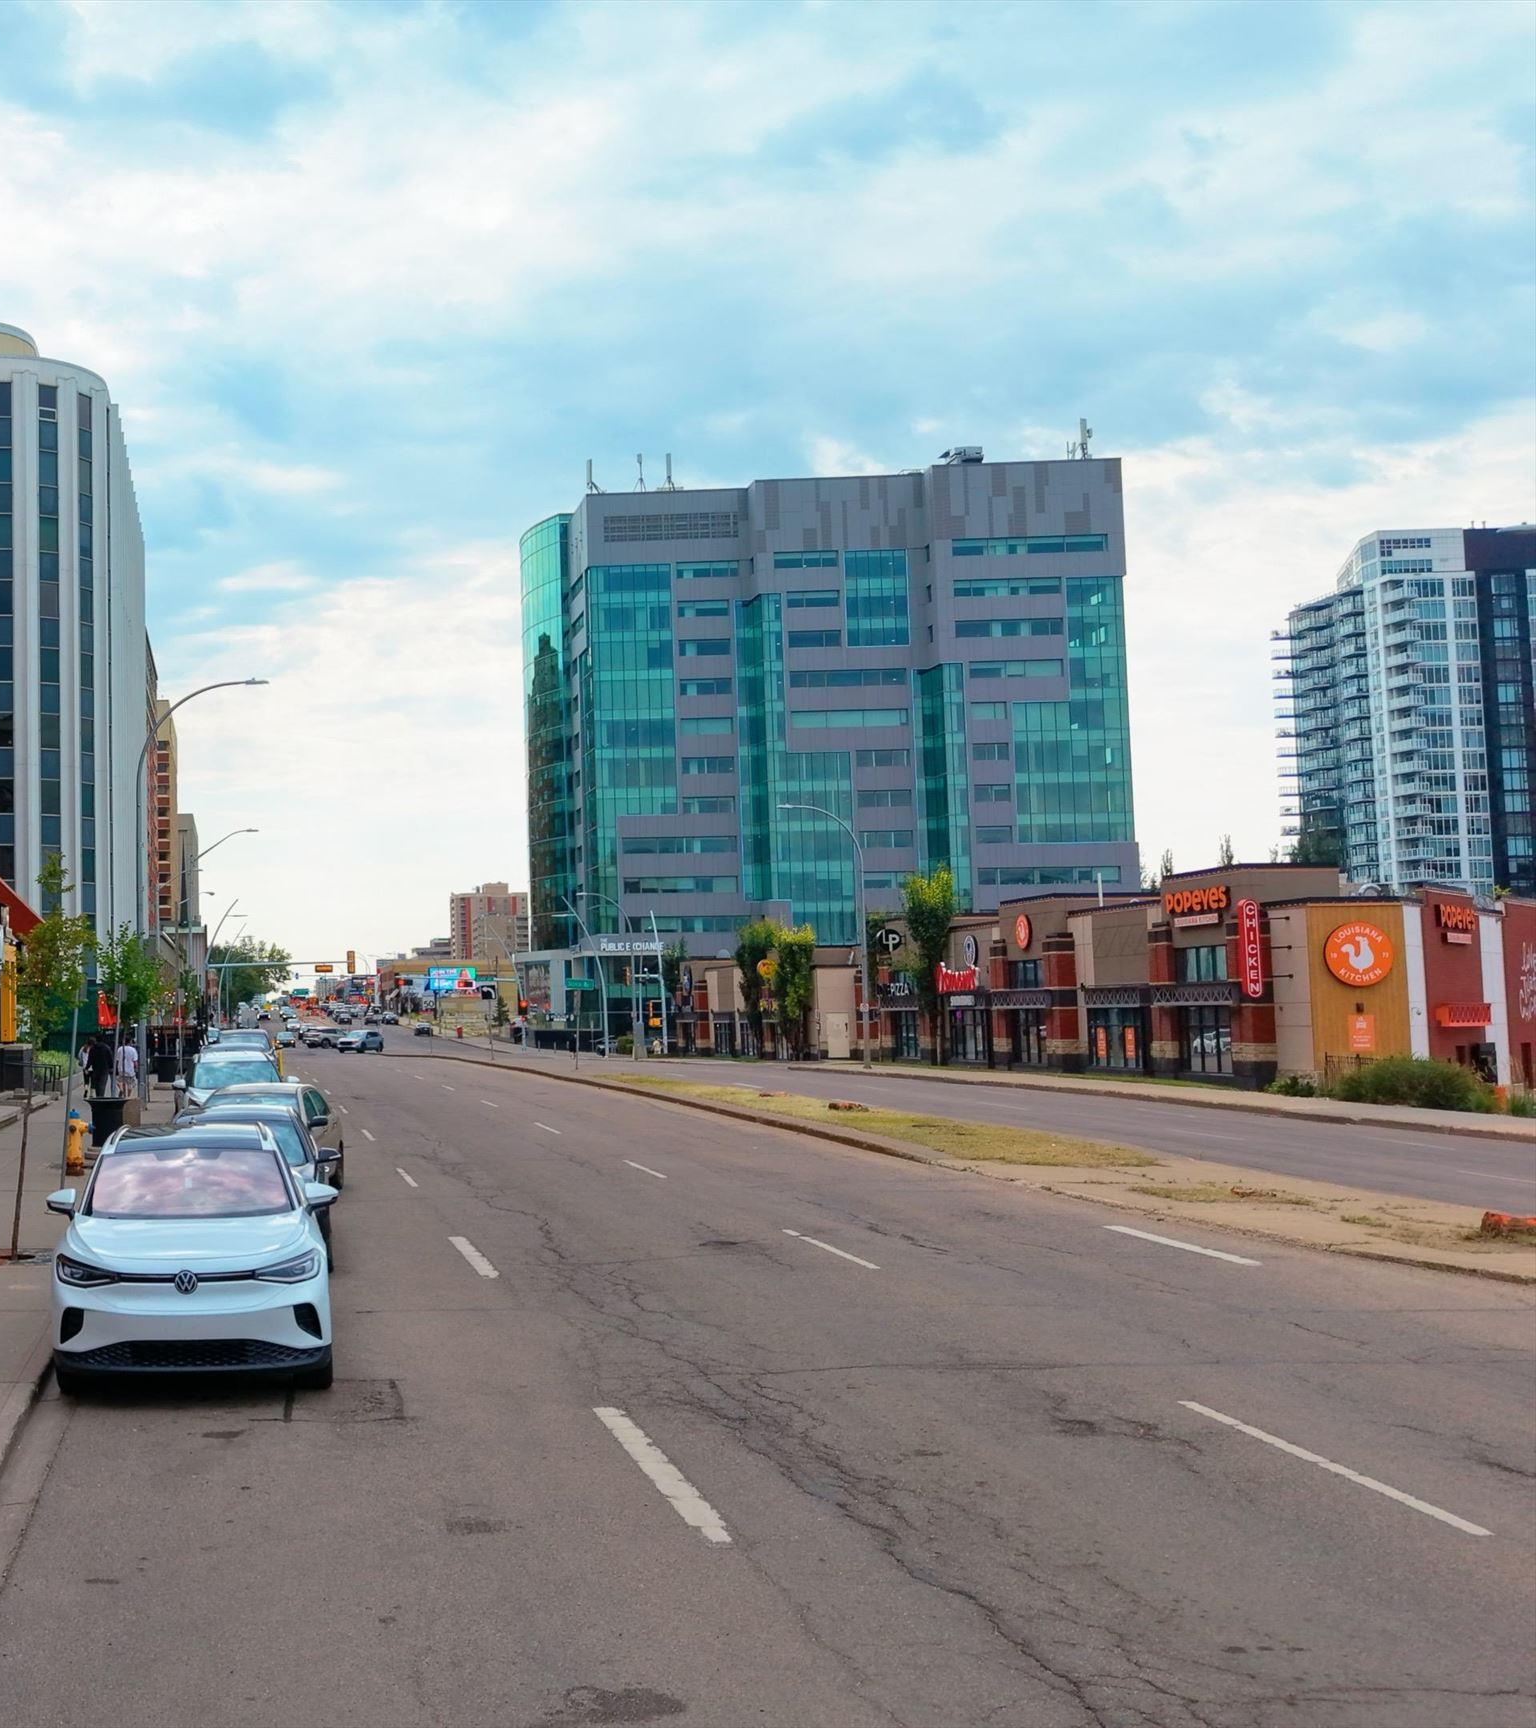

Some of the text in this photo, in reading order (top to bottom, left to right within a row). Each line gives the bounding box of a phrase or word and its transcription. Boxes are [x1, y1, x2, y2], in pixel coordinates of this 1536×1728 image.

[1334, 926, 1384, 944] LOUISIANA
[600, 942, 625, 951] PUBLIC
[1245, 905, 1260, 993] CHICKEN
[1339, 968, 1383, 982] KITCHEN
